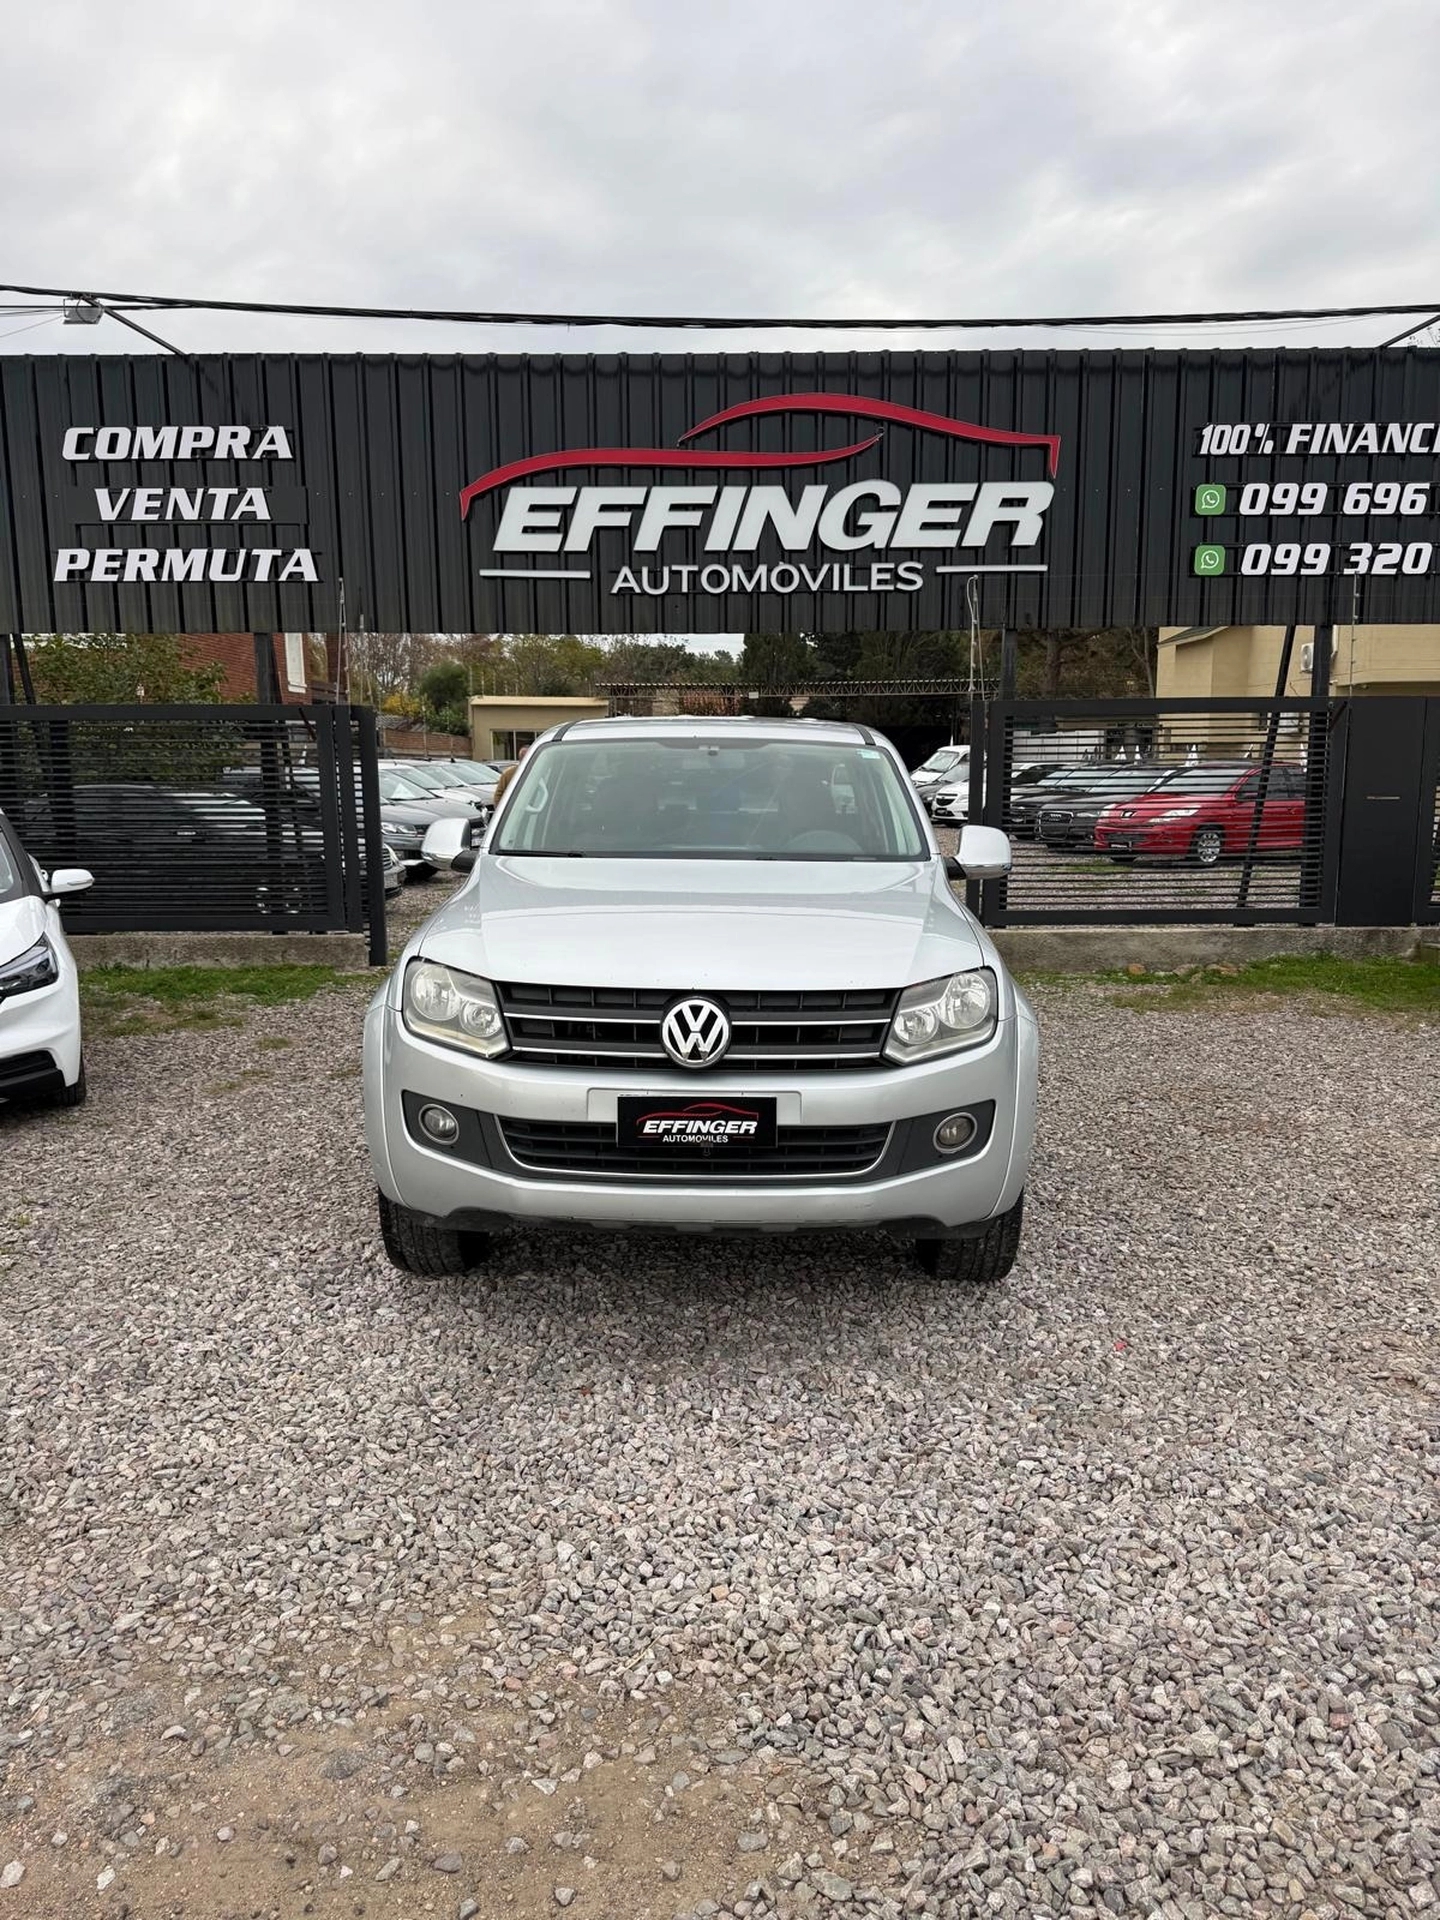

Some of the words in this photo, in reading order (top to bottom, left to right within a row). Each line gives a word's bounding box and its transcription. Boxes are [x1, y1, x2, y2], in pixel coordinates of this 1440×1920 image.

[62, 425, 293, 461] COMPRA
[1200, 423, 1274, 455] 100%
[94, 487, 271, 521] VENTA
[493, 480, 1055, 552] EFFINGER
[1239, 482, 1328, 516] 099
[1342, 482, 1431, 516] 696
[54, 548, 319, 582] PERMUTA
[1240, 543, 1331, 576] 099
[1343, 542, 1433, 576] 320
[611, 562, 924, 595] AUTOMOVILES
[643, 1120, 758, 1134] EFFINGER
[662, 1134, 729, 1144] AUTOMOVILES
